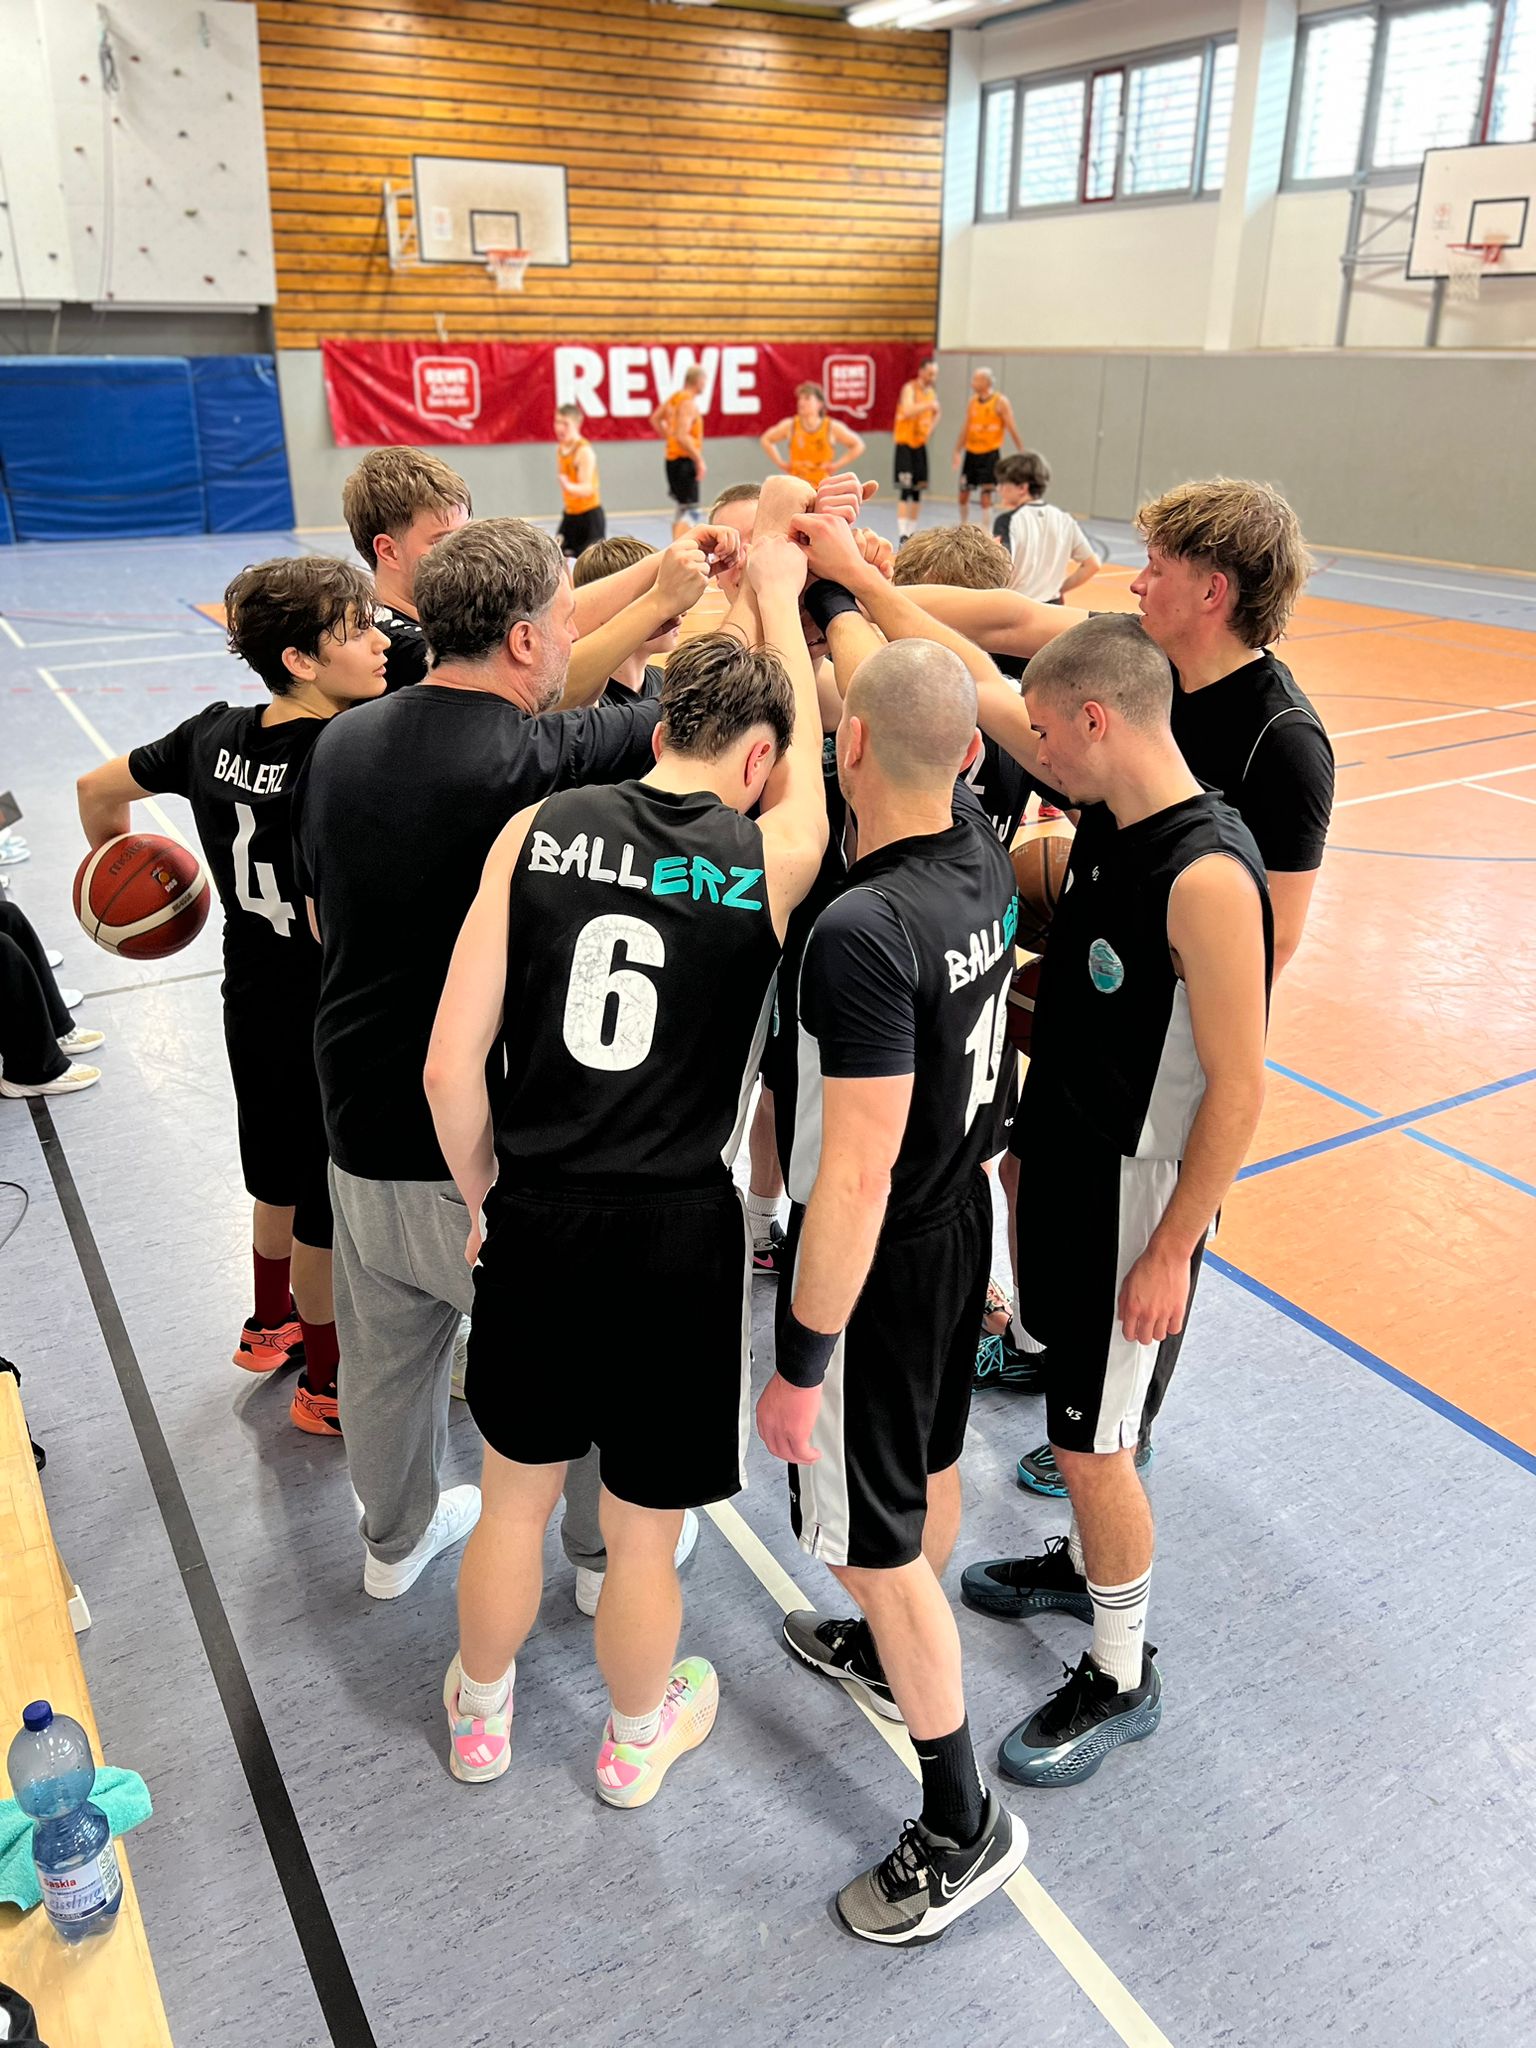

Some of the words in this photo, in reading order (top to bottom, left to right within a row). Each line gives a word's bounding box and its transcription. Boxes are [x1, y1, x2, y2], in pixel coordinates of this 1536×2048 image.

[553, 345, 761, 418] REWE
[213, 748, 288, 795] BALLERZ
[232, 801, 296, 938] 4
[528, 830, 765, 911] BALLERZ
[944, 894, 1019, 994] BALLE
[562, 913, 667, 1072] 6
